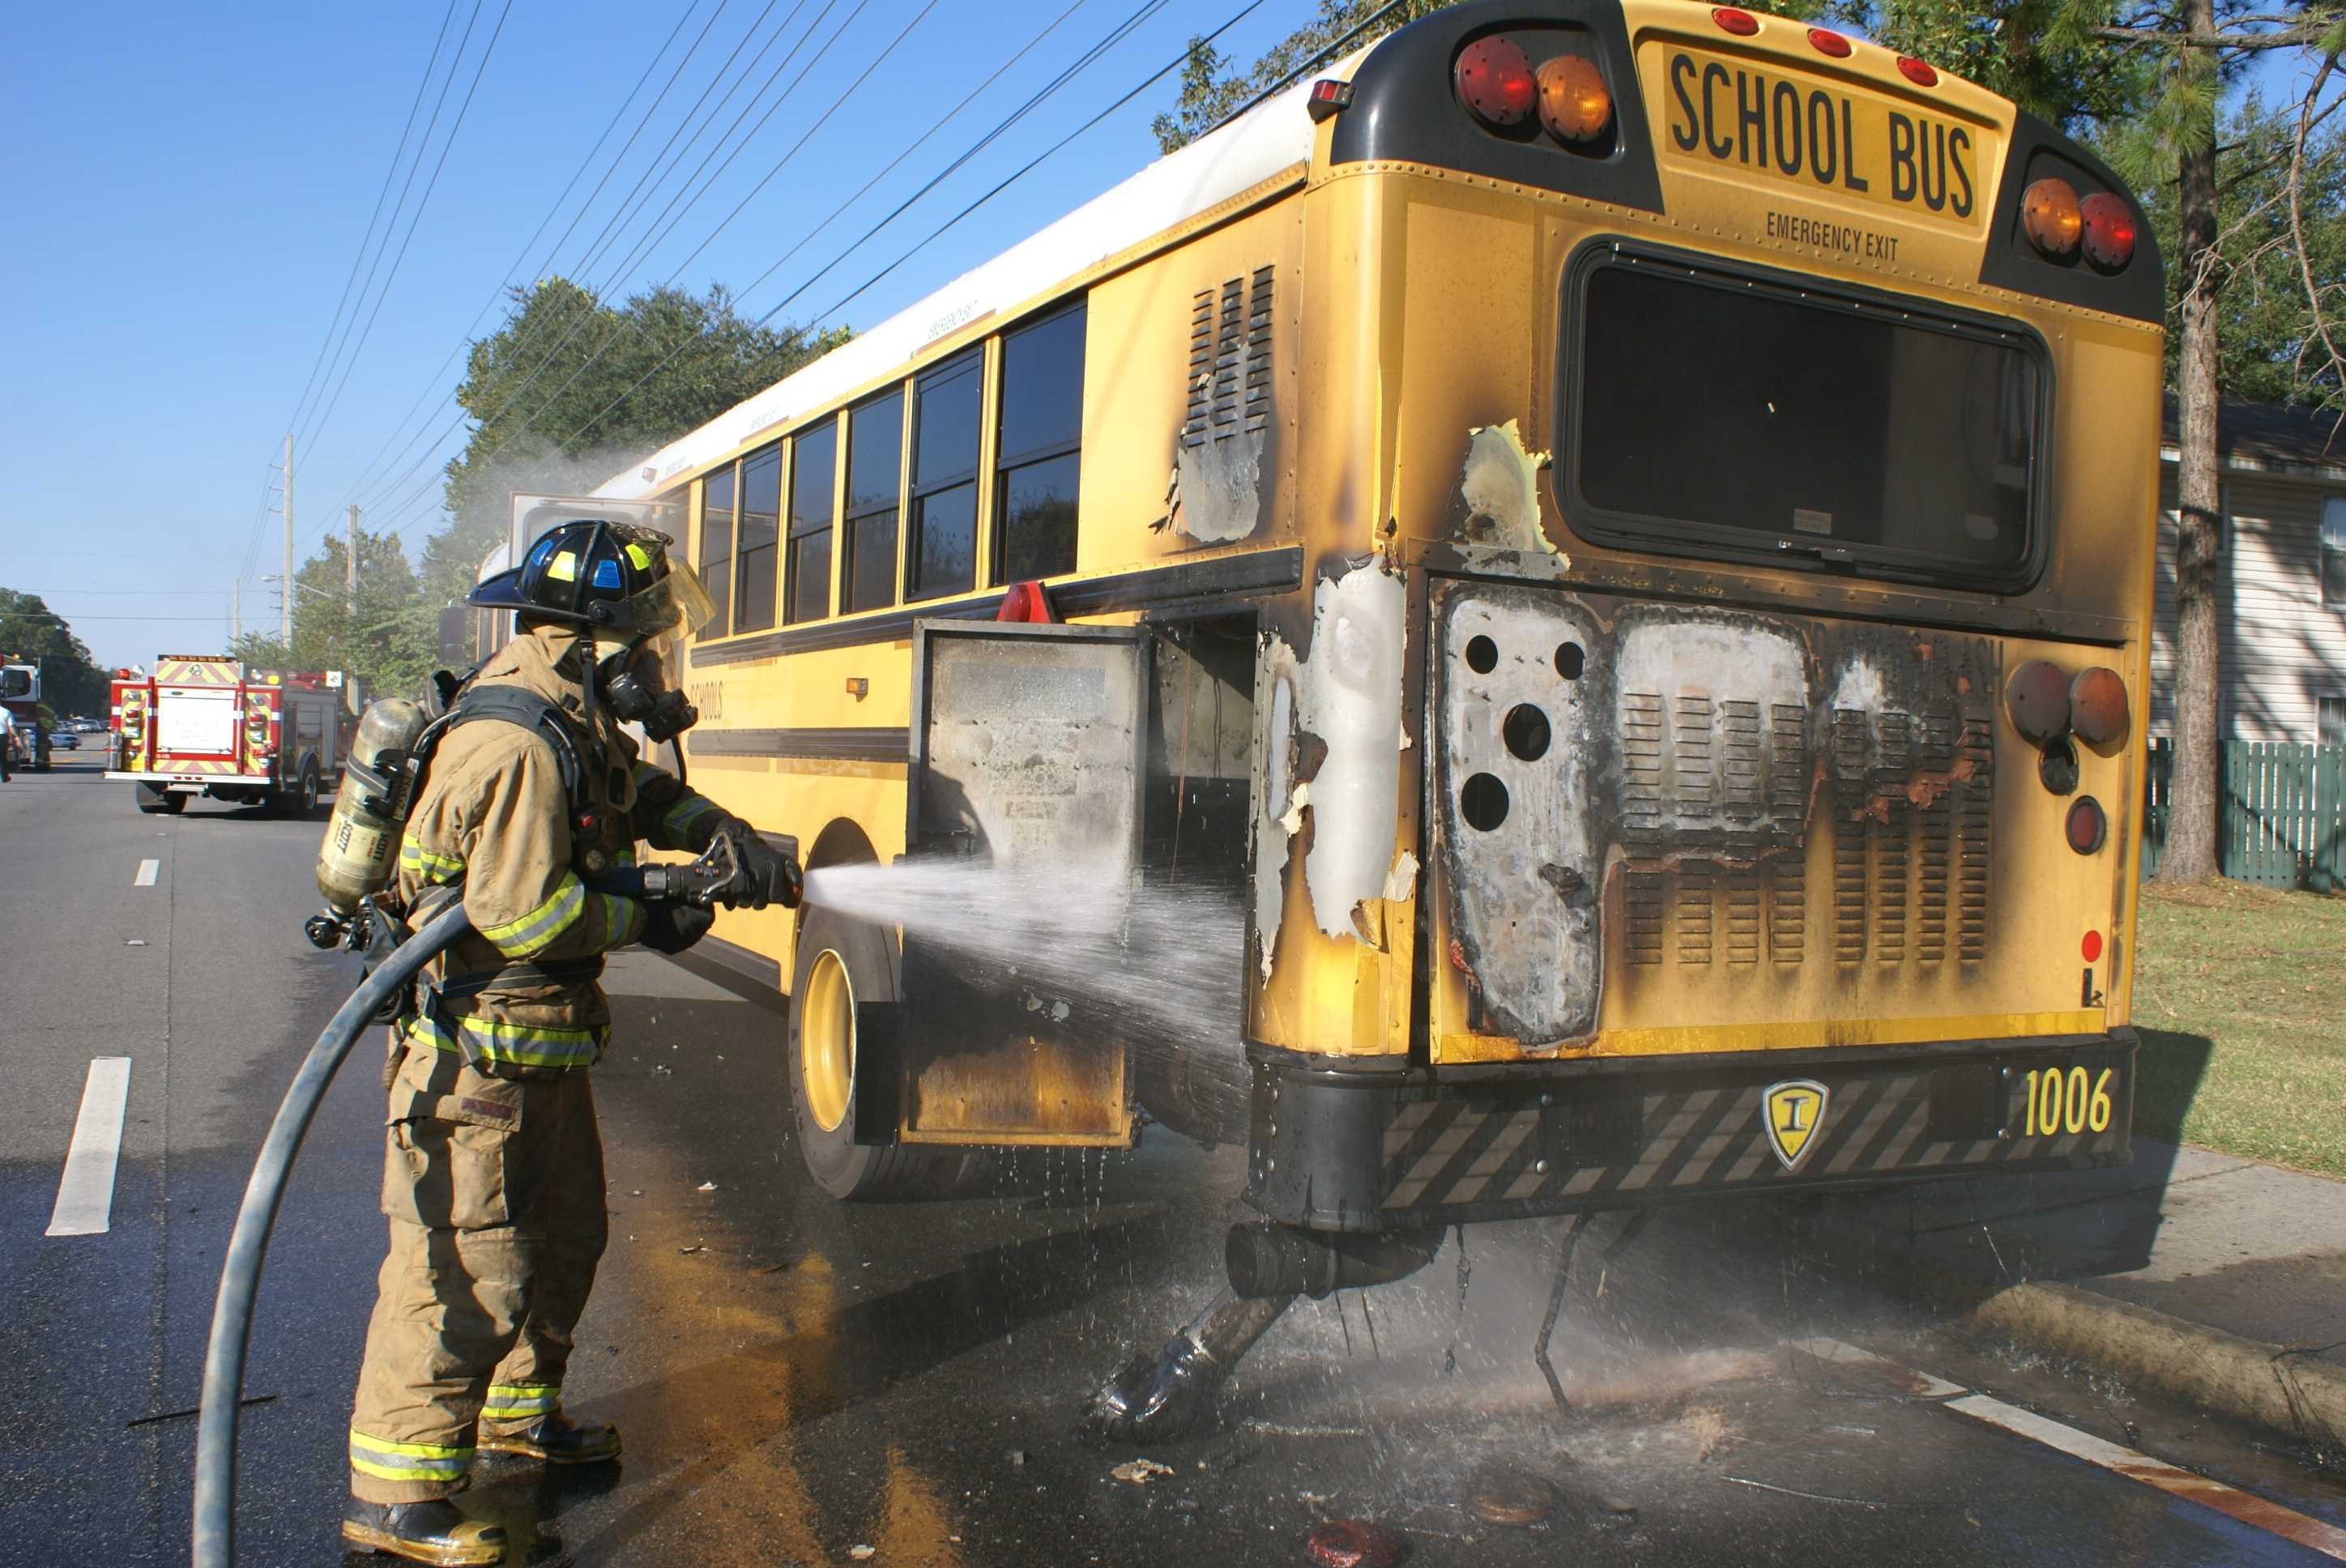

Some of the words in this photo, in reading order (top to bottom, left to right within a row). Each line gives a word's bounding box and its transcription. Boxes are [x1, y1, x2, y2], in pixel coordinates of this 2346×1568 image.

[1670, 53, 1869, 193] SCHOOL
[1888, 110, 1973, 218] BUS
[1767, 211, 1862, 254] EMERGENCY
[1866, 232, 1898, 261] EXIT
[689, 680, 723, 720] SCHOOLS
[336, 820, 353, 854] SCOTT
[373, 831, 390, 862] SCOTT
[2026, 1066, 2112, 1136] 1006
